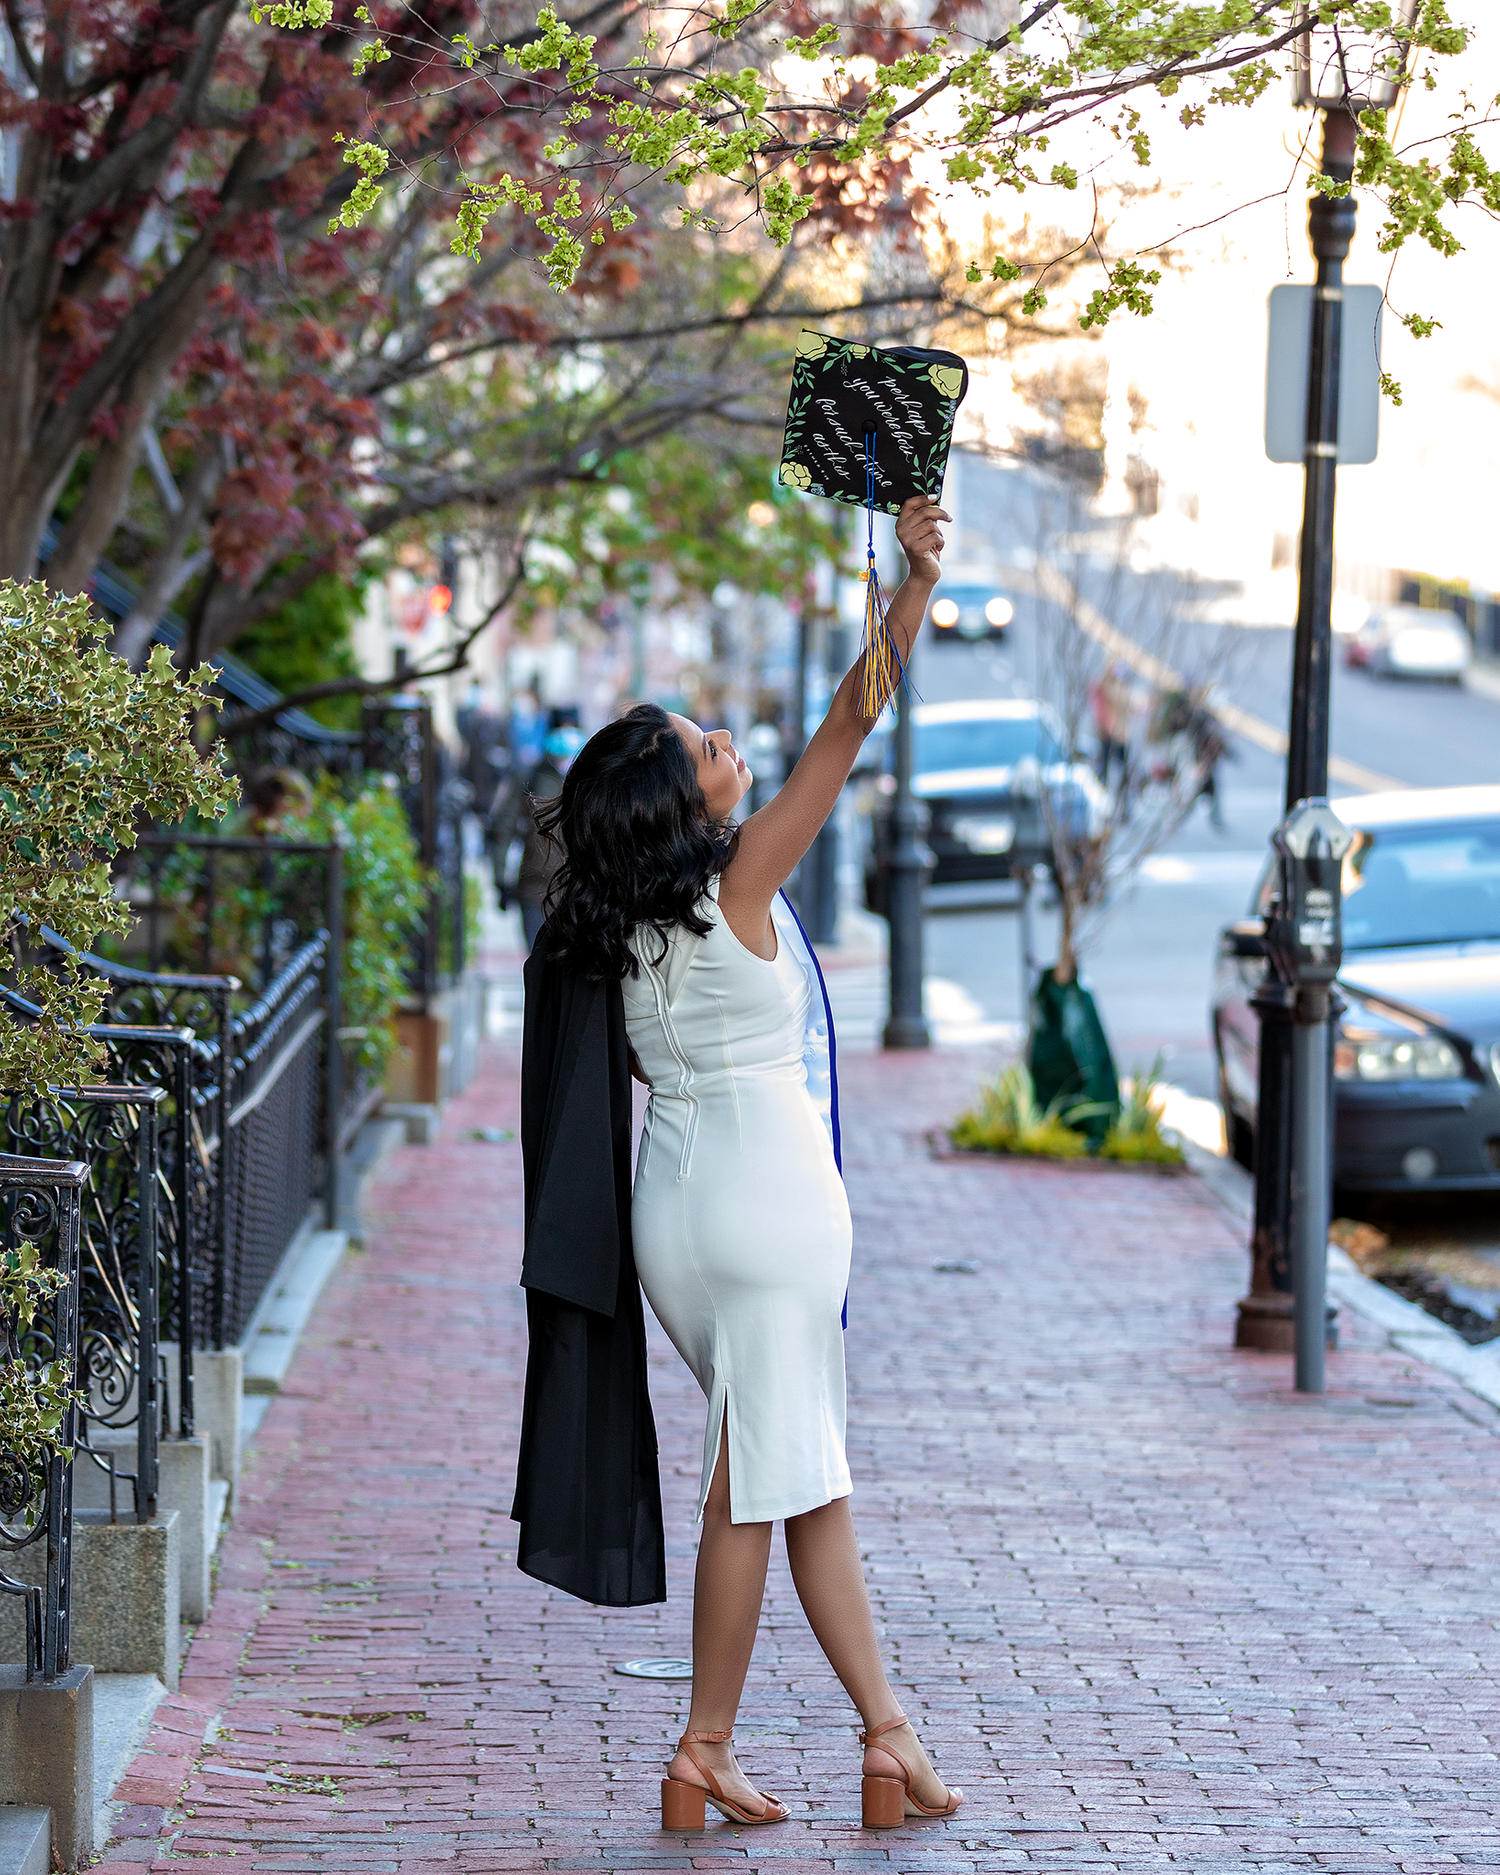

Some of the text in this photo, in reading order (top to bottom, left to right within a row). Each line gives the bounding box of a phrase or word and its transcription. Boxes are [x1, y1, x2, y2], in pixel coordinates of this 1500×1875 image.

[815, 398, 839, 417] for
[827, 417, 864, 453] such
[854, 453, 867, 462] a
[843, 378, 880, 399] you
[874, 400, 901, 431] were
[877, 376, 932, 436] perhaps
[812, 433, 831, 449] as
[824, 446, 851, 480] this
